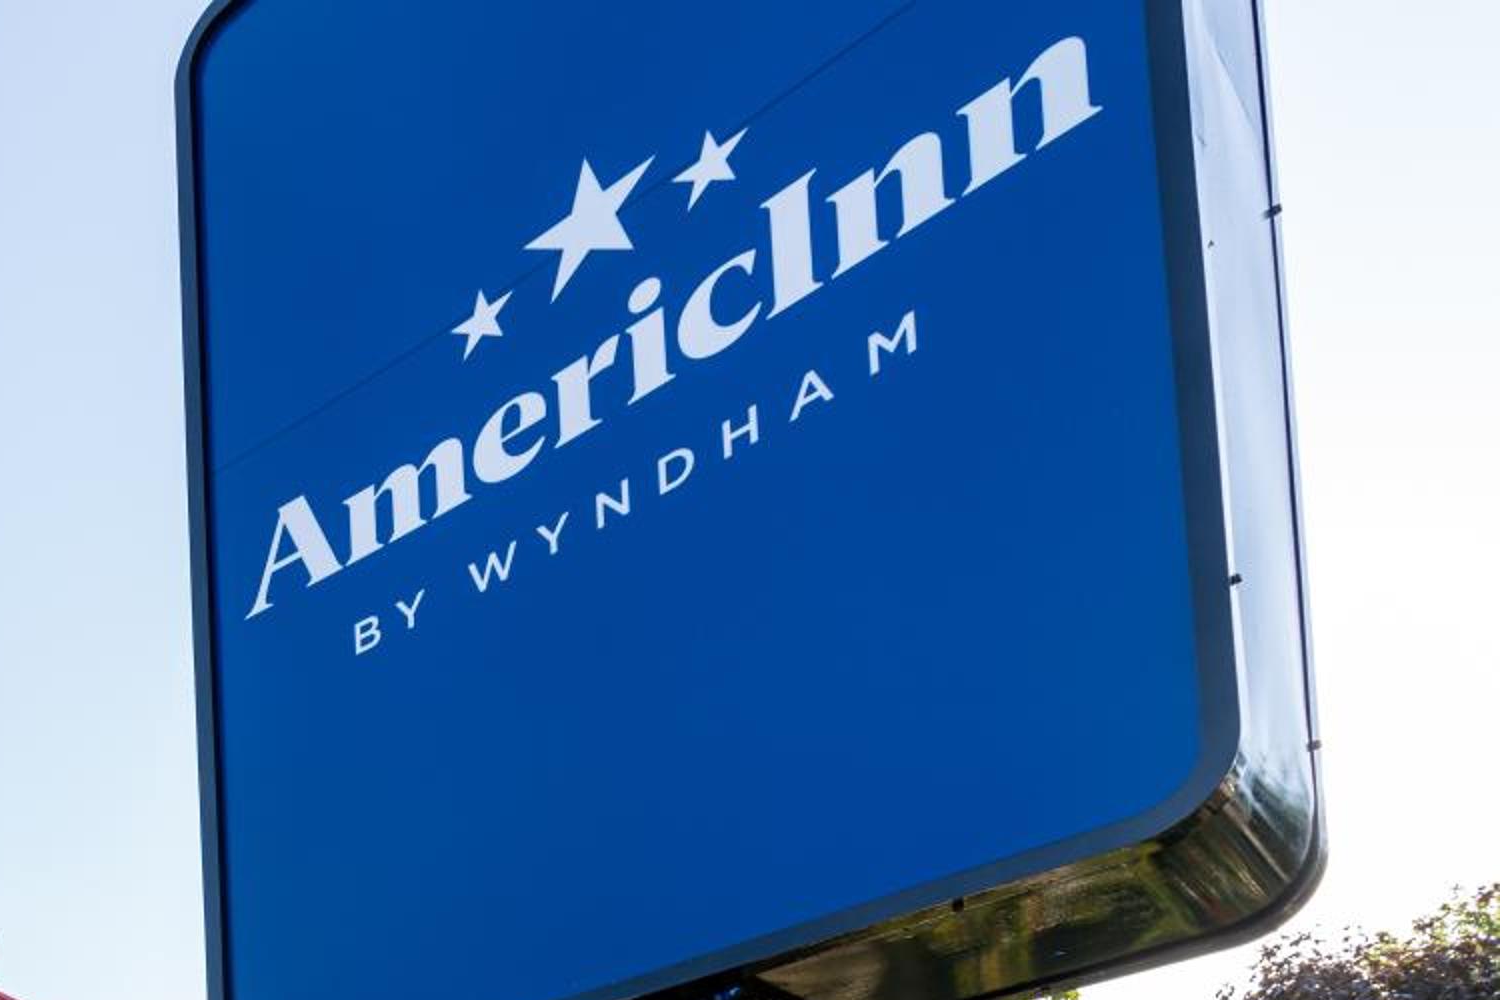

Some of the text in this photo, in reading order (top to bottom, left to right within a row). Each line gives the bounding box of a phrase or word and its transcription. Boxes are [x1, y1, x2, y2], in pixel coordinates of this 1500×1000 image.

[245, 35, 1103, 620] AmericInn
[353, 310, 918, 656] BY WYNDHAM
